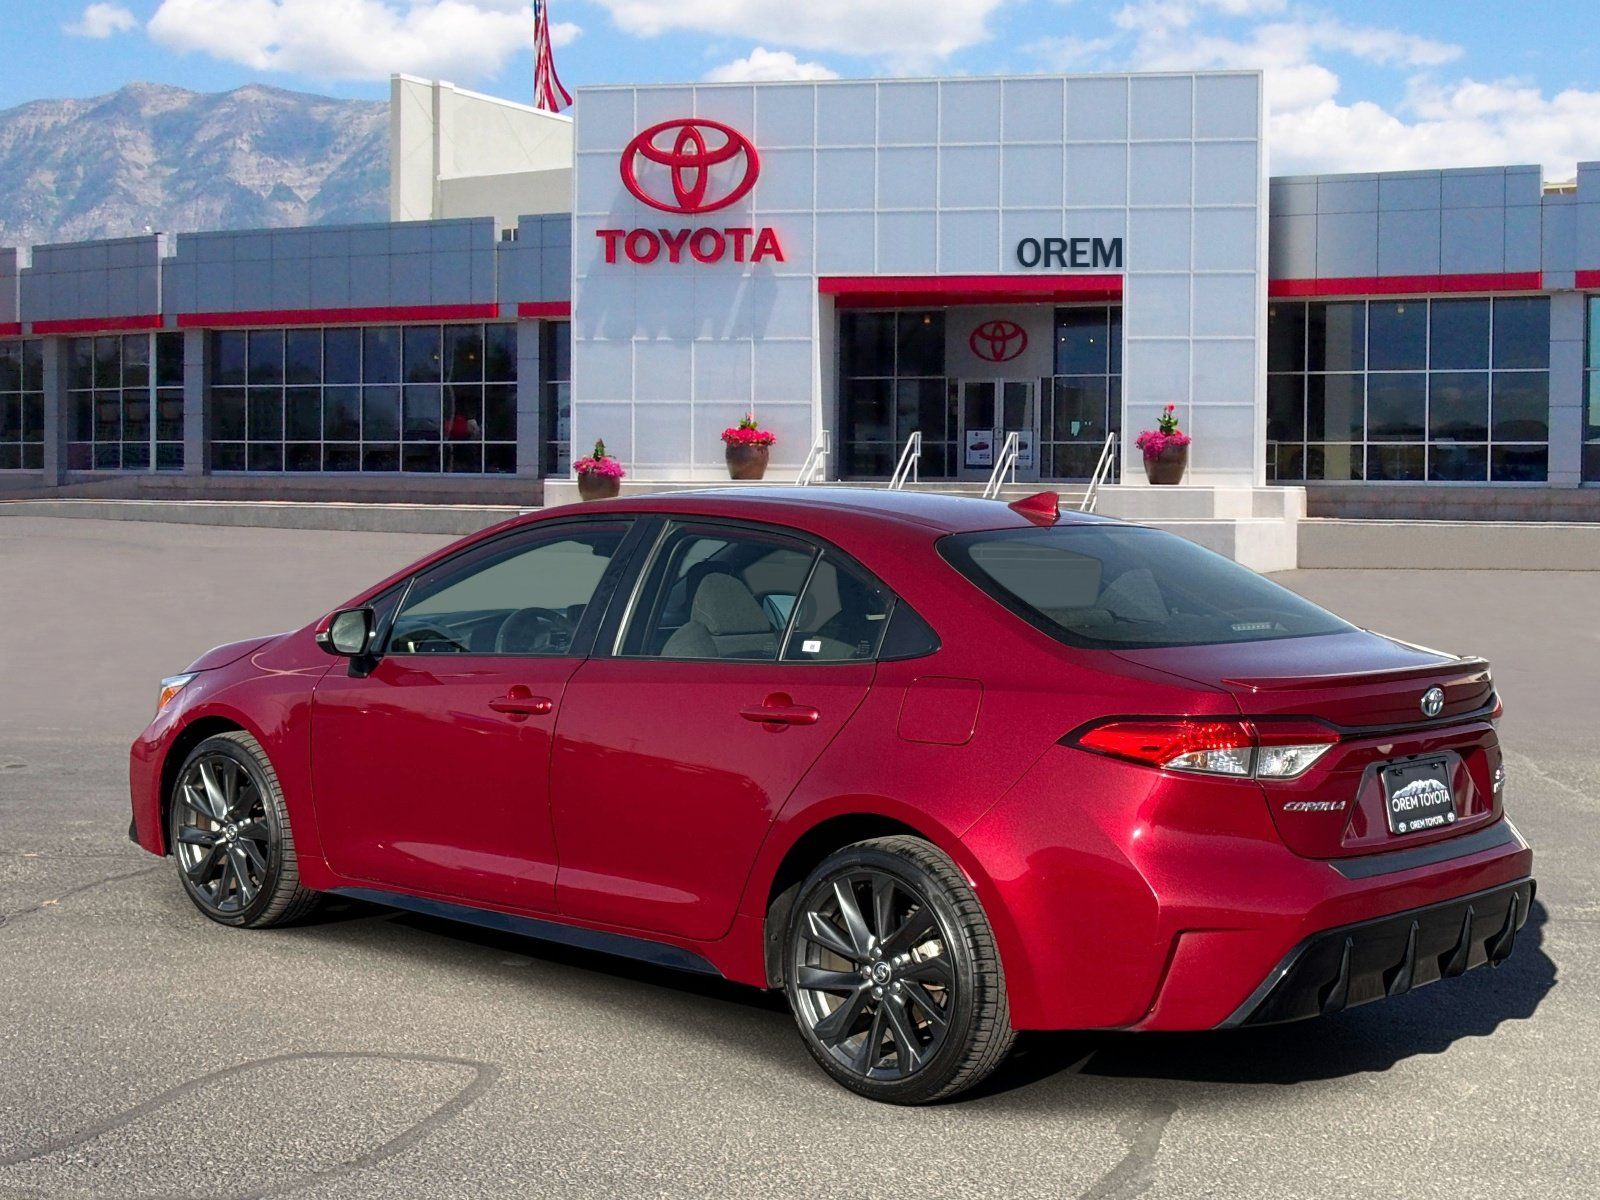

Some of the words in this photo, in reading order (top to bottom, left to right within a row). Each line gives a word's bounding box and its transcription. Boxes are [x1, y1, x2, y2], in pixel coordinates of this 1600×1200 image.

[596, 227, 785, 264] TOYOTA
[1016, 237, 1123, 268] OREM
[1391, 795, 1419, 812] OREM
[1418, 789, 1451, 807] TOYOTA
[1409, 819, 1426, 830] OREM
[1424, 815, 1445, 827] TOYOTA
